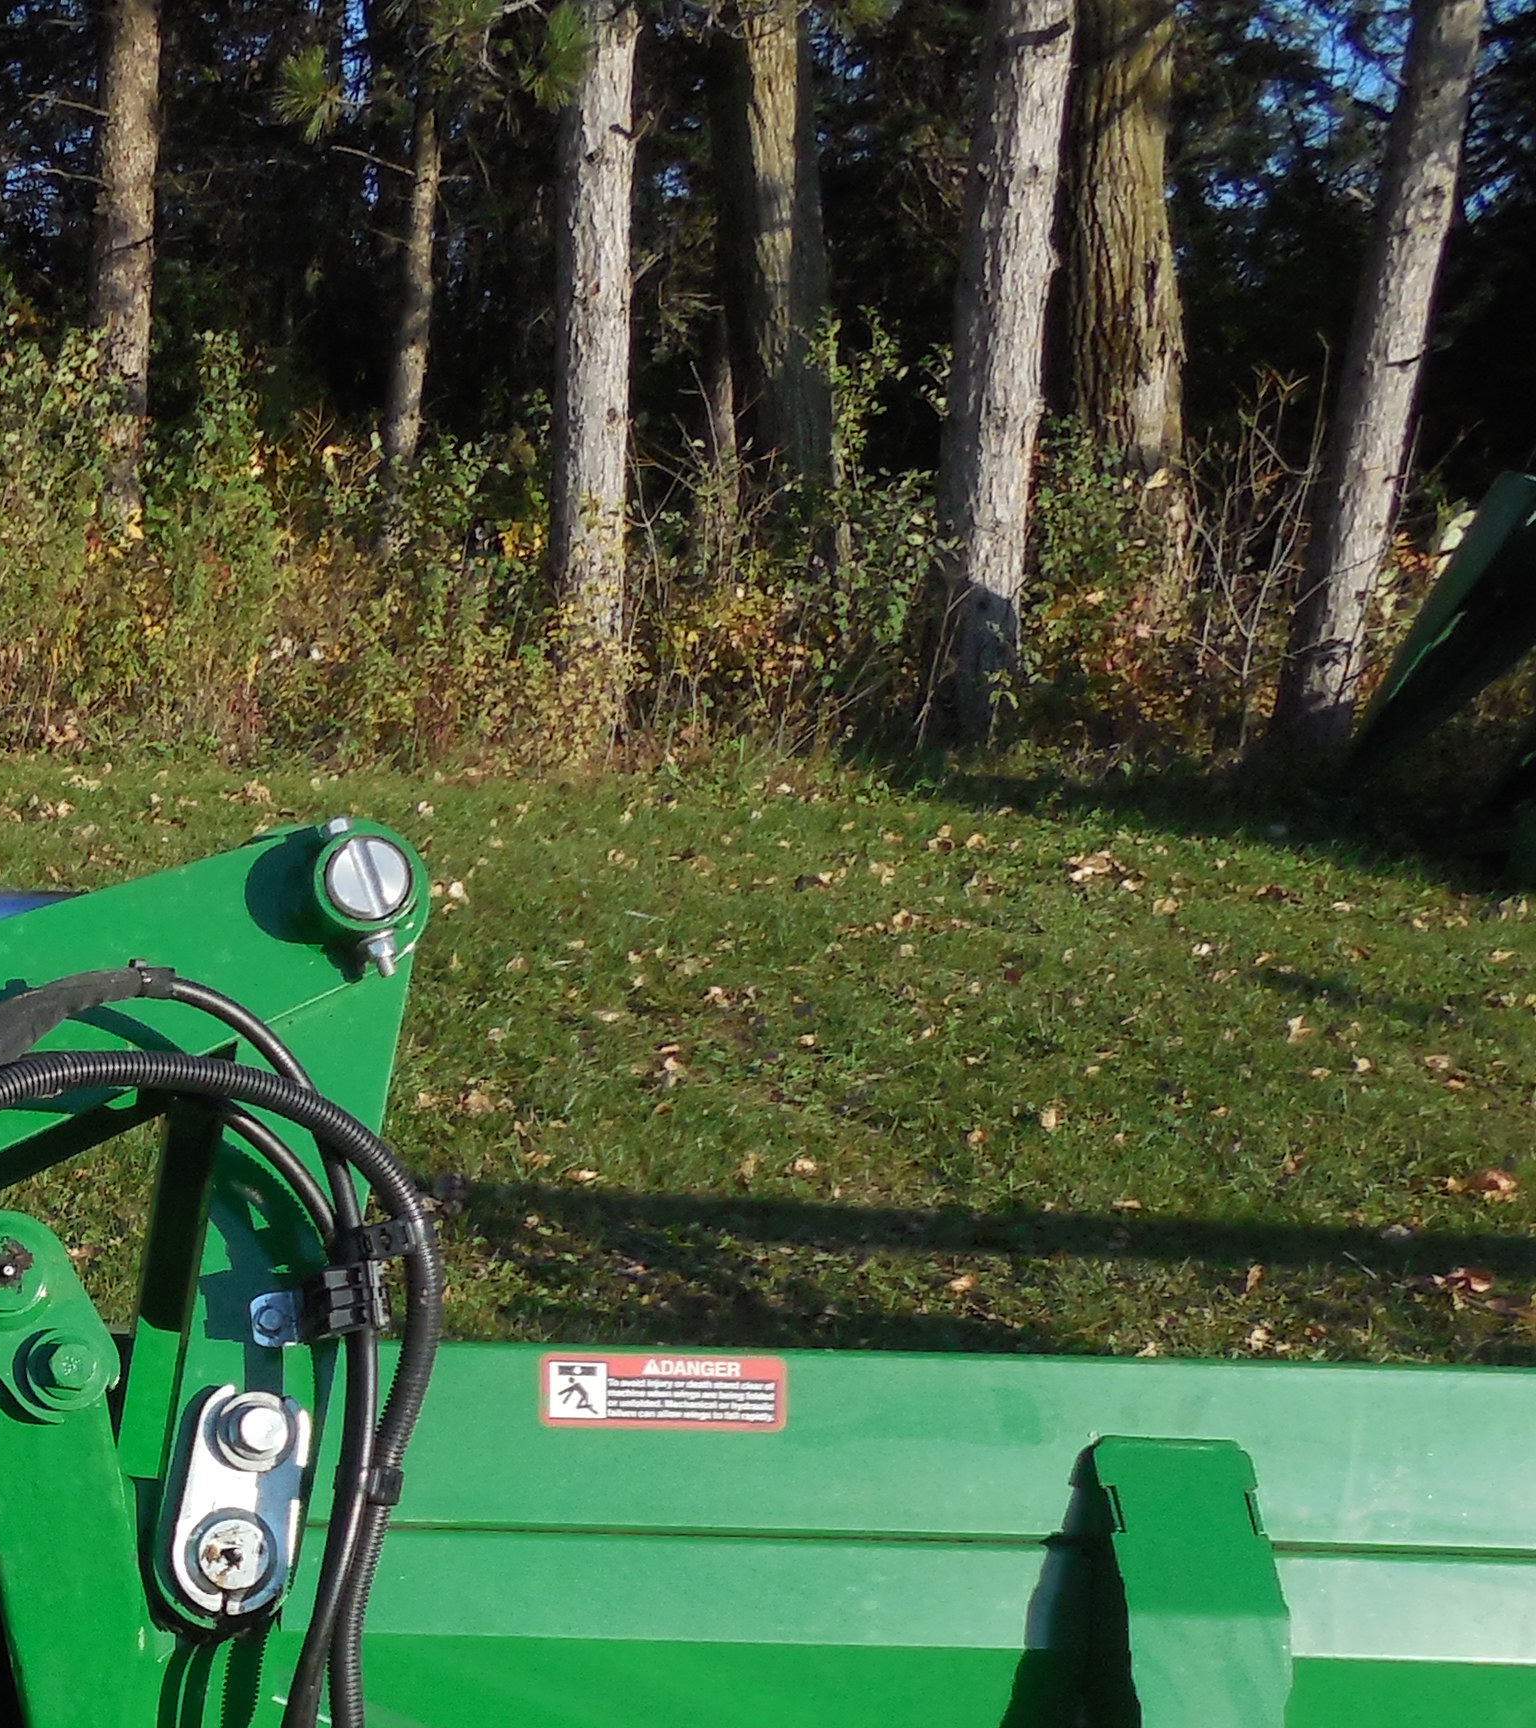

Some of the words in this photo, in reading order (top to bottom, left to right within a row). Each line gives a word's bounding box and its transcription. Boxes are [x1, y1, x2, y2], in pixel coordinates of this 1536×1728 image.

[661, 1360, 740, 1377] DANGER
[607, 1378, 619, 1387] To
[620, 1379, 646, 1388] avoid
[647, 1380, 673, 1390] injury
[686, 1380, 712, 1389] death
[713, 1381, 740, 1390] stand
[740, 1382, 764, 1390] clear
[764, 1382, 776, 1391] of
[607, 1389, 646, 1398] machine
[647, 1390, 672, 1398] when
[673, 1390, 701, 1401] wings
[702, 1392, 717, 1400] are
[718, 1391, 745, 1402] being
[746, 1392, 776, 1401] folded
[619, 1399, 662, 1408] unfolded.
[664, 1400, 717, 1409] Mechanical
[718, 1402, 729, 1410] or
[730, 1401, 776, 1411] hydraulic
[607, 1409, 637, 1418] failure
[657, 1410, 682, 1419] allow
[683, 1411, 711, 1421] wings
[712, 1411, 723, 1420] to
[724, 1411, 740, 1420] fall
[741, 1412, 776, 1423] rapidly.
